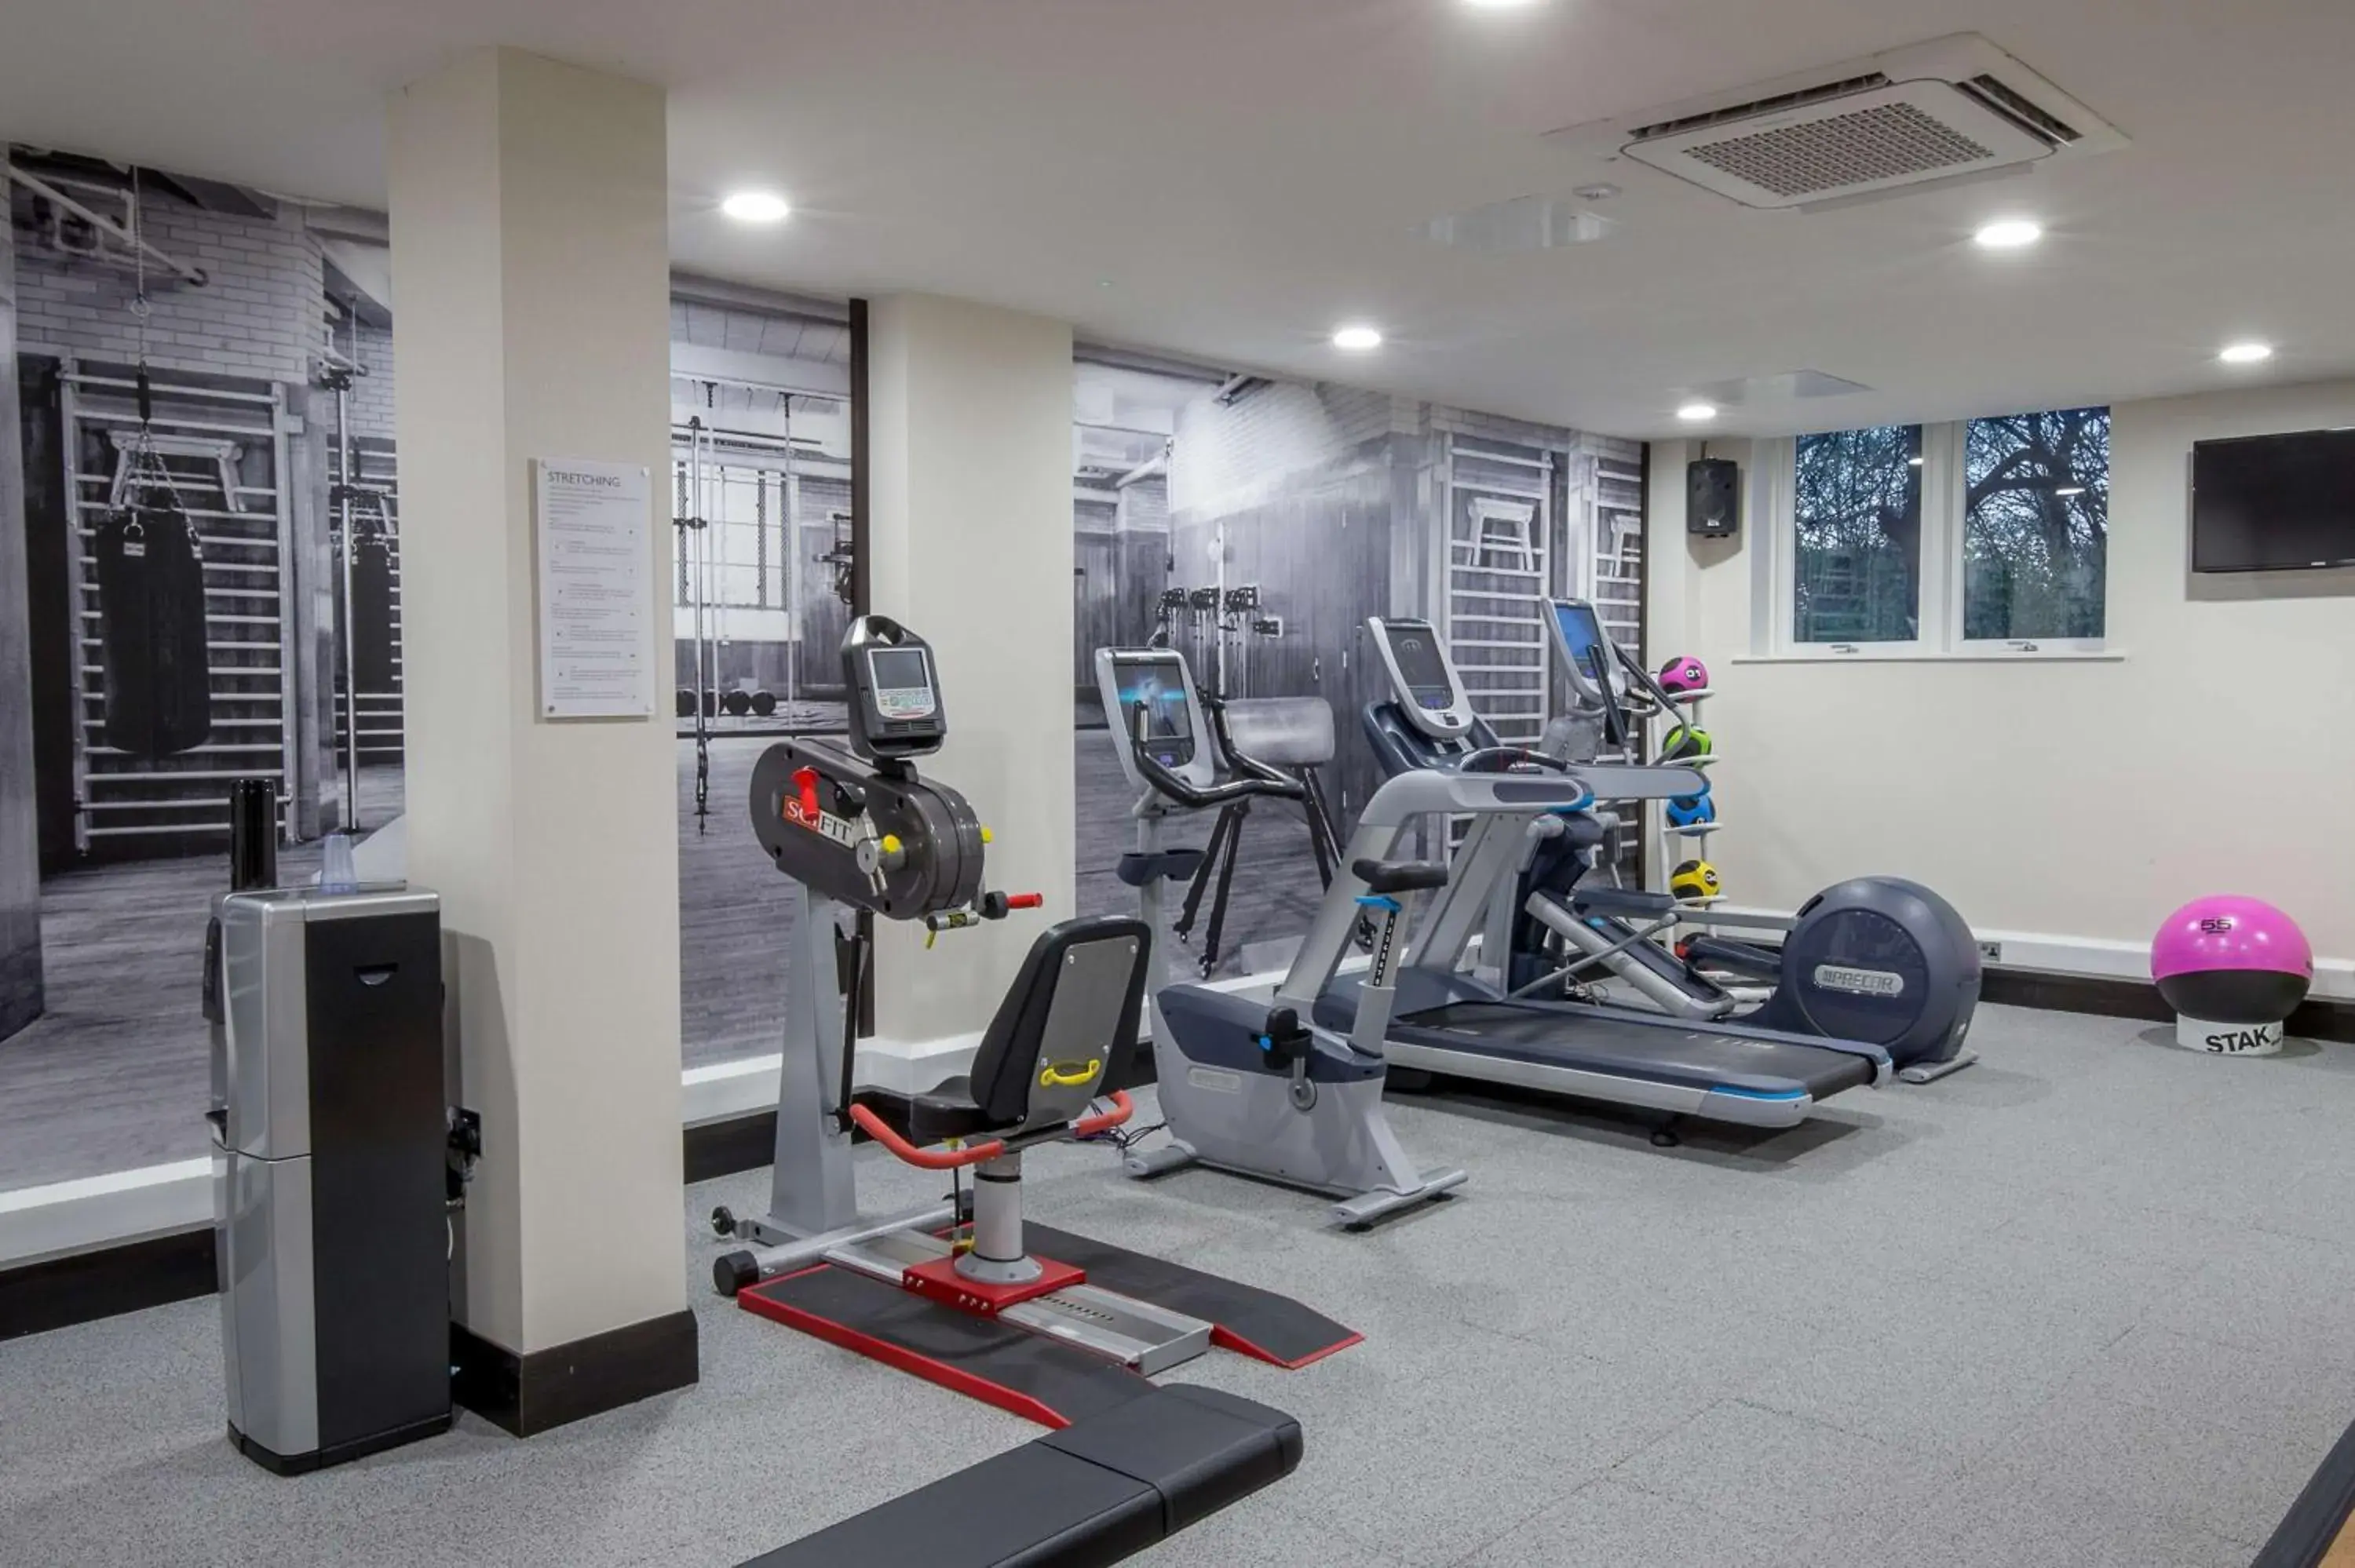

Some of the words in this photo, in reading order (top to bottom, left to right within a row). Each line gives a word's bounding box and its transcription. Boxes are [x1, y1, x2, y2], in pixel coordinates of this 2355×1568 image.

[547, 472, 622, 487] STRETCHING
[2201, 919, 2233, 931] 55
[1831, 971, 1893, 991] PRECOR
[2205, 1026, 2271, 1053] STAK
